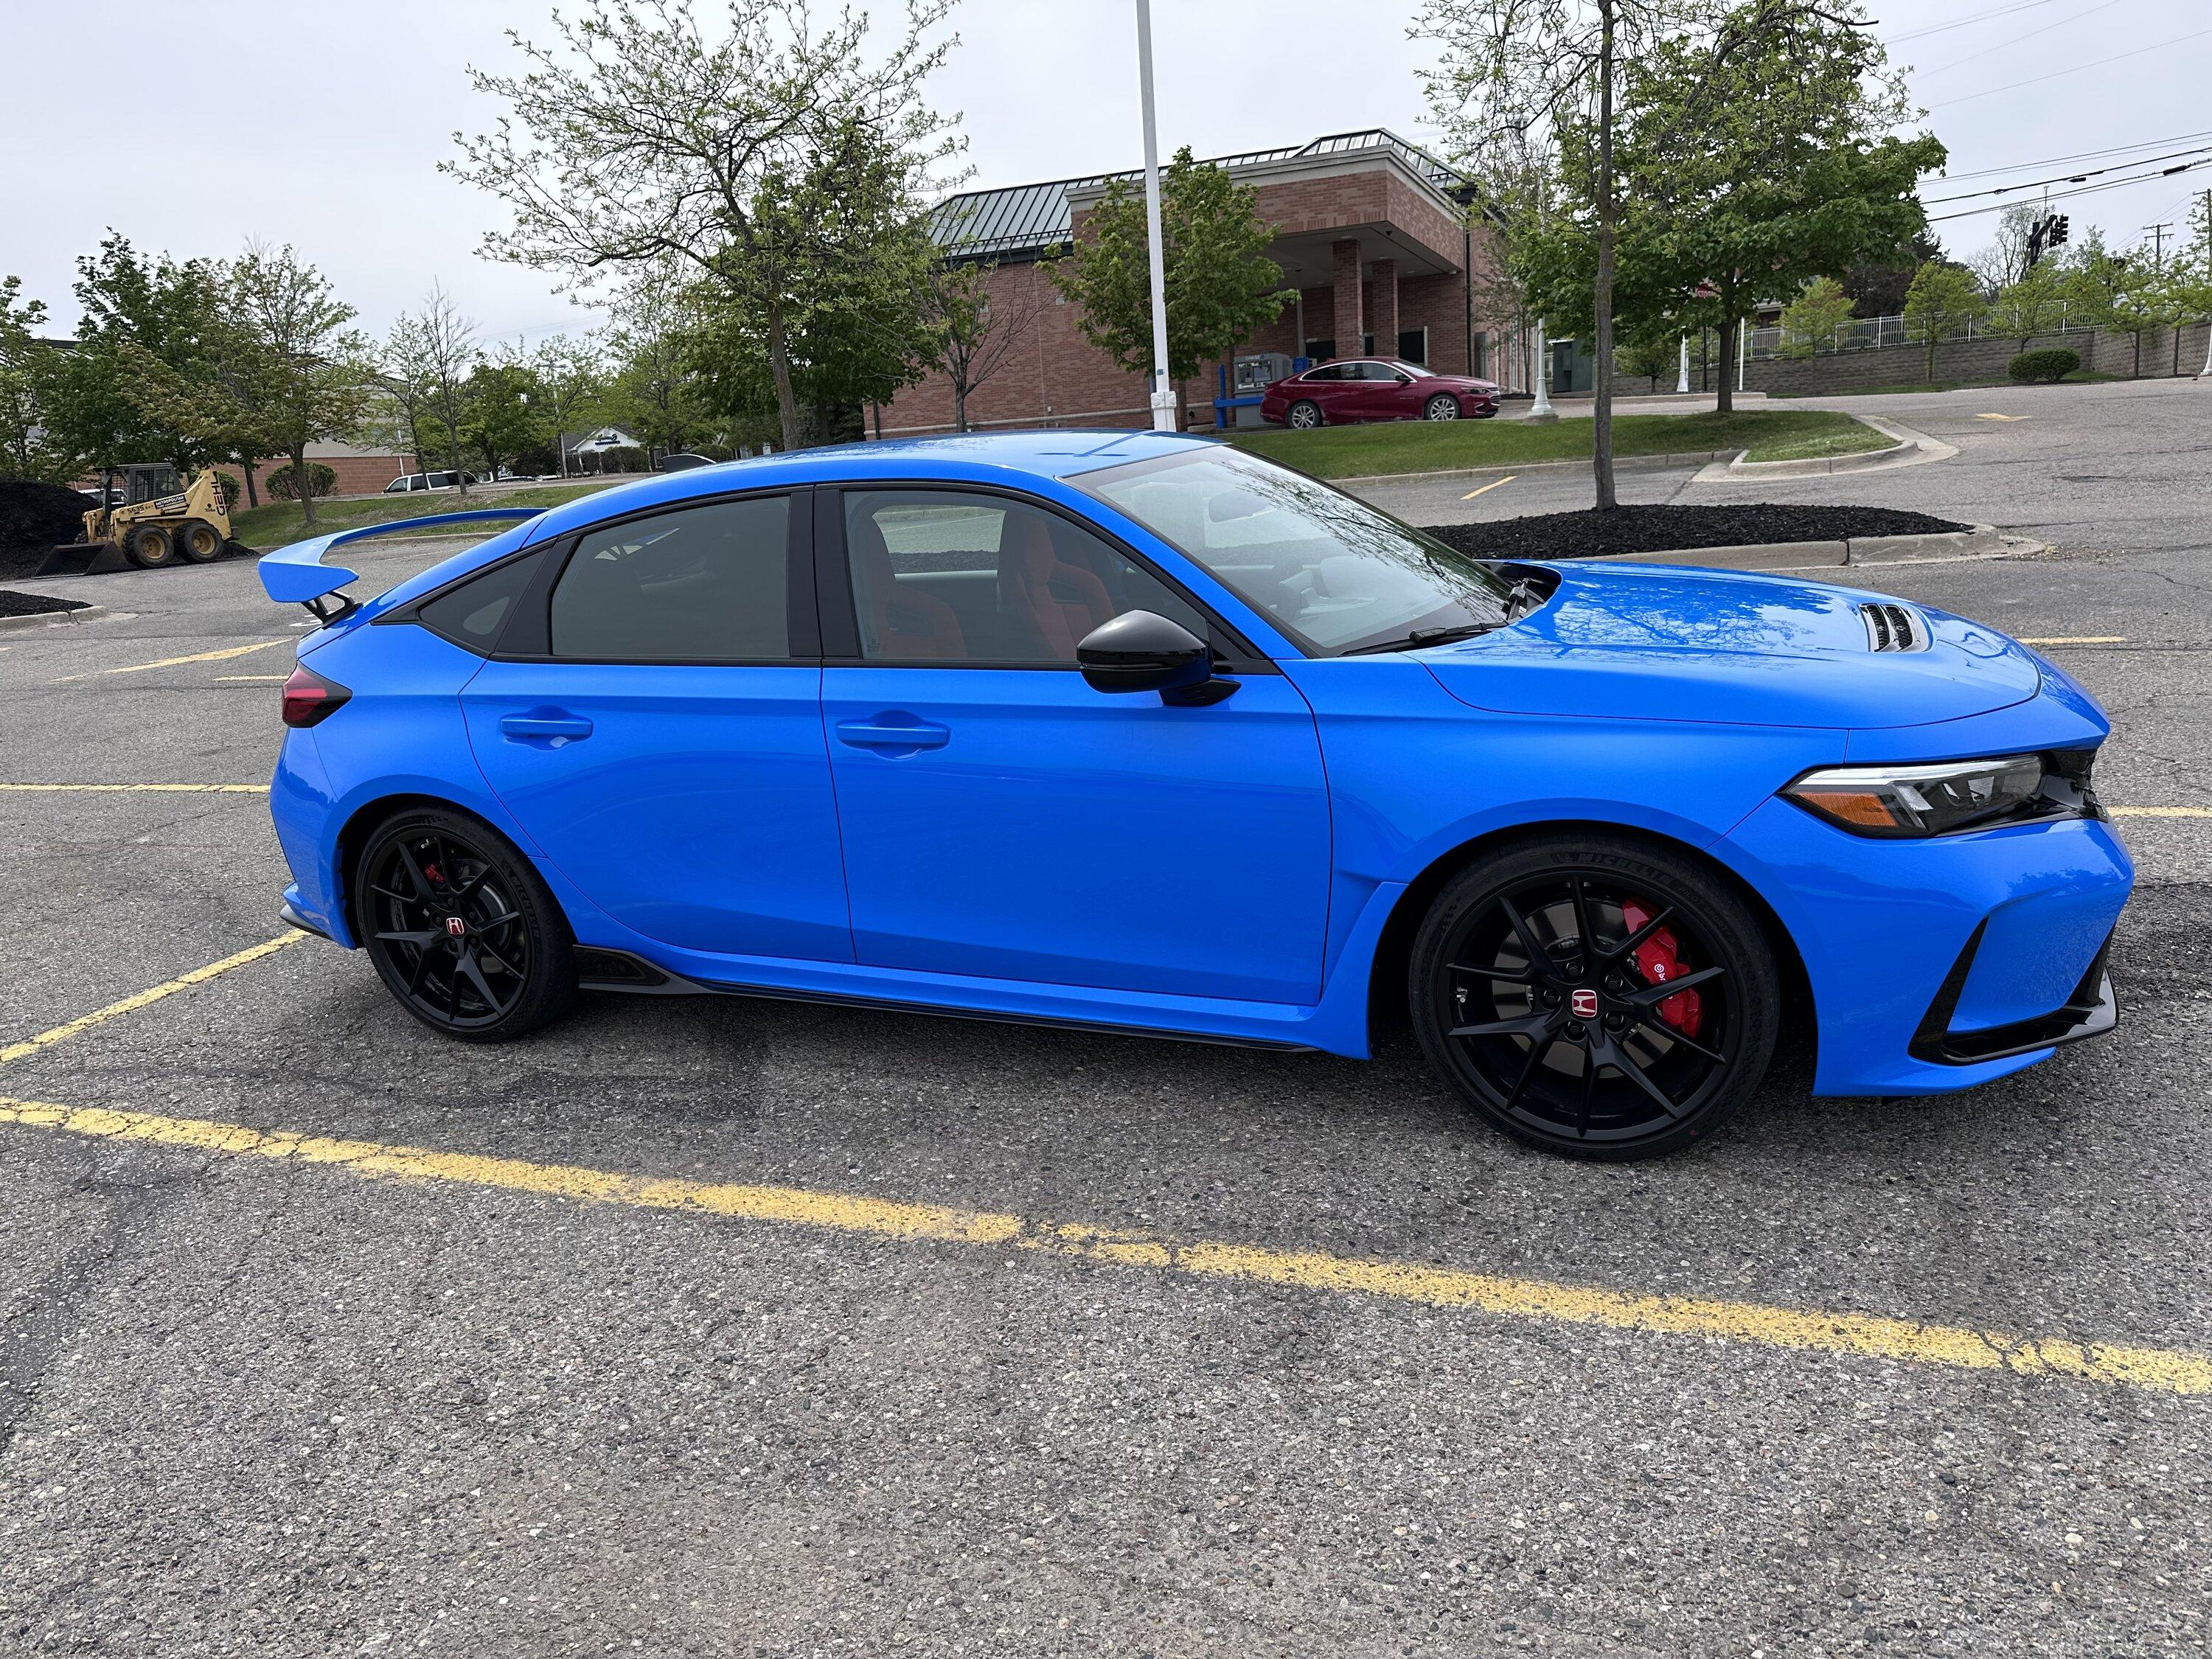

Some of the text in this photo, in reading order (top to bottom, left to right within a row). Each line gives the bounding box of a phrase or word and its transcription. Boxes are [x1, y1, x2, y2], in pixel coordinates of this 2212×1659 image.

[127, 506, 145, 514] 5635
[156, 495, 184, 507] METROPOLITAN
[211, 471, 226, 516] GEHL
[1578, 853, 1674, 886] MICHELIN
[510, 875, 541, 938] MICHELIN
